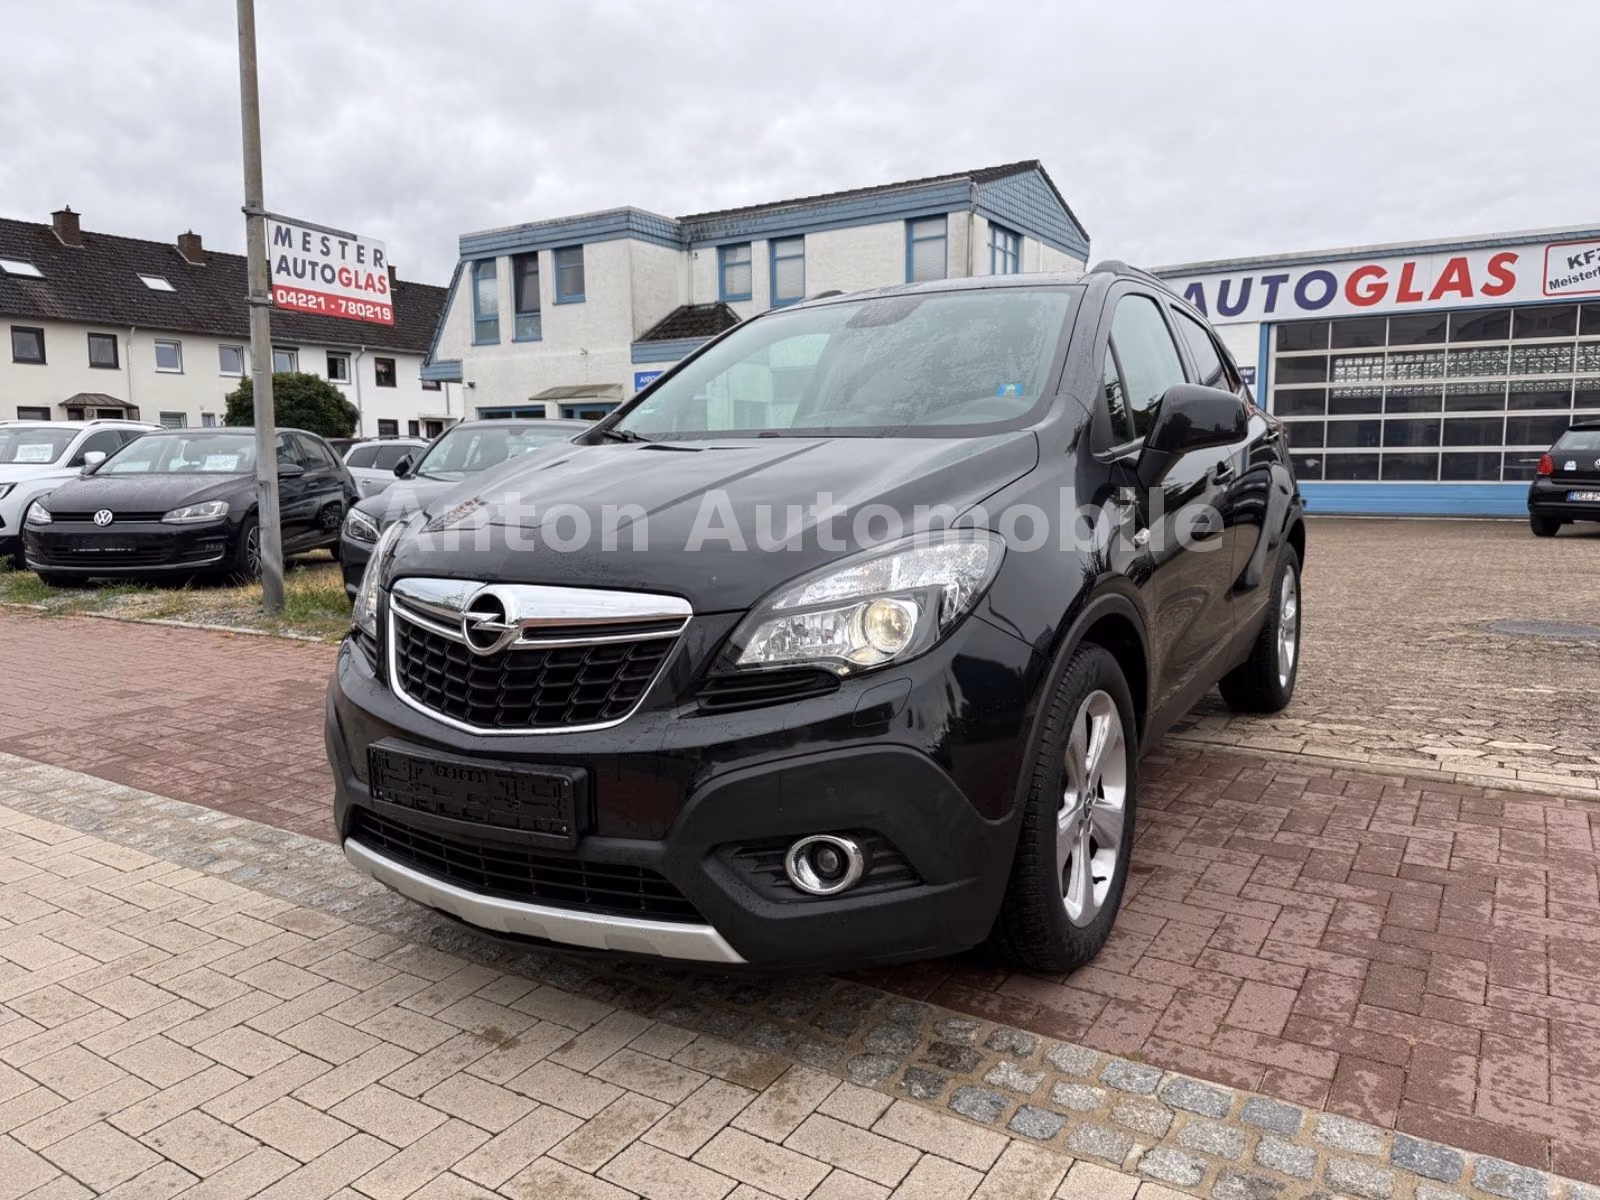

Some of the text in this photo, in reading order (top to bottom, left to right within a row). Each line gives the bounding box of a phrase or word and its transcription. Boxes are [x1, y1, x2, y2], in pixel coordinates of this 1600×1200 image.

[274, 225, 384, 268] MESTER
[275, 254, 387, 295] AUTOGLAS
[1180, 252, 1519, 318] AUTOGLAS
[276, 289, 326, 310] 04221
[338, 299, 391, 320] 780219
